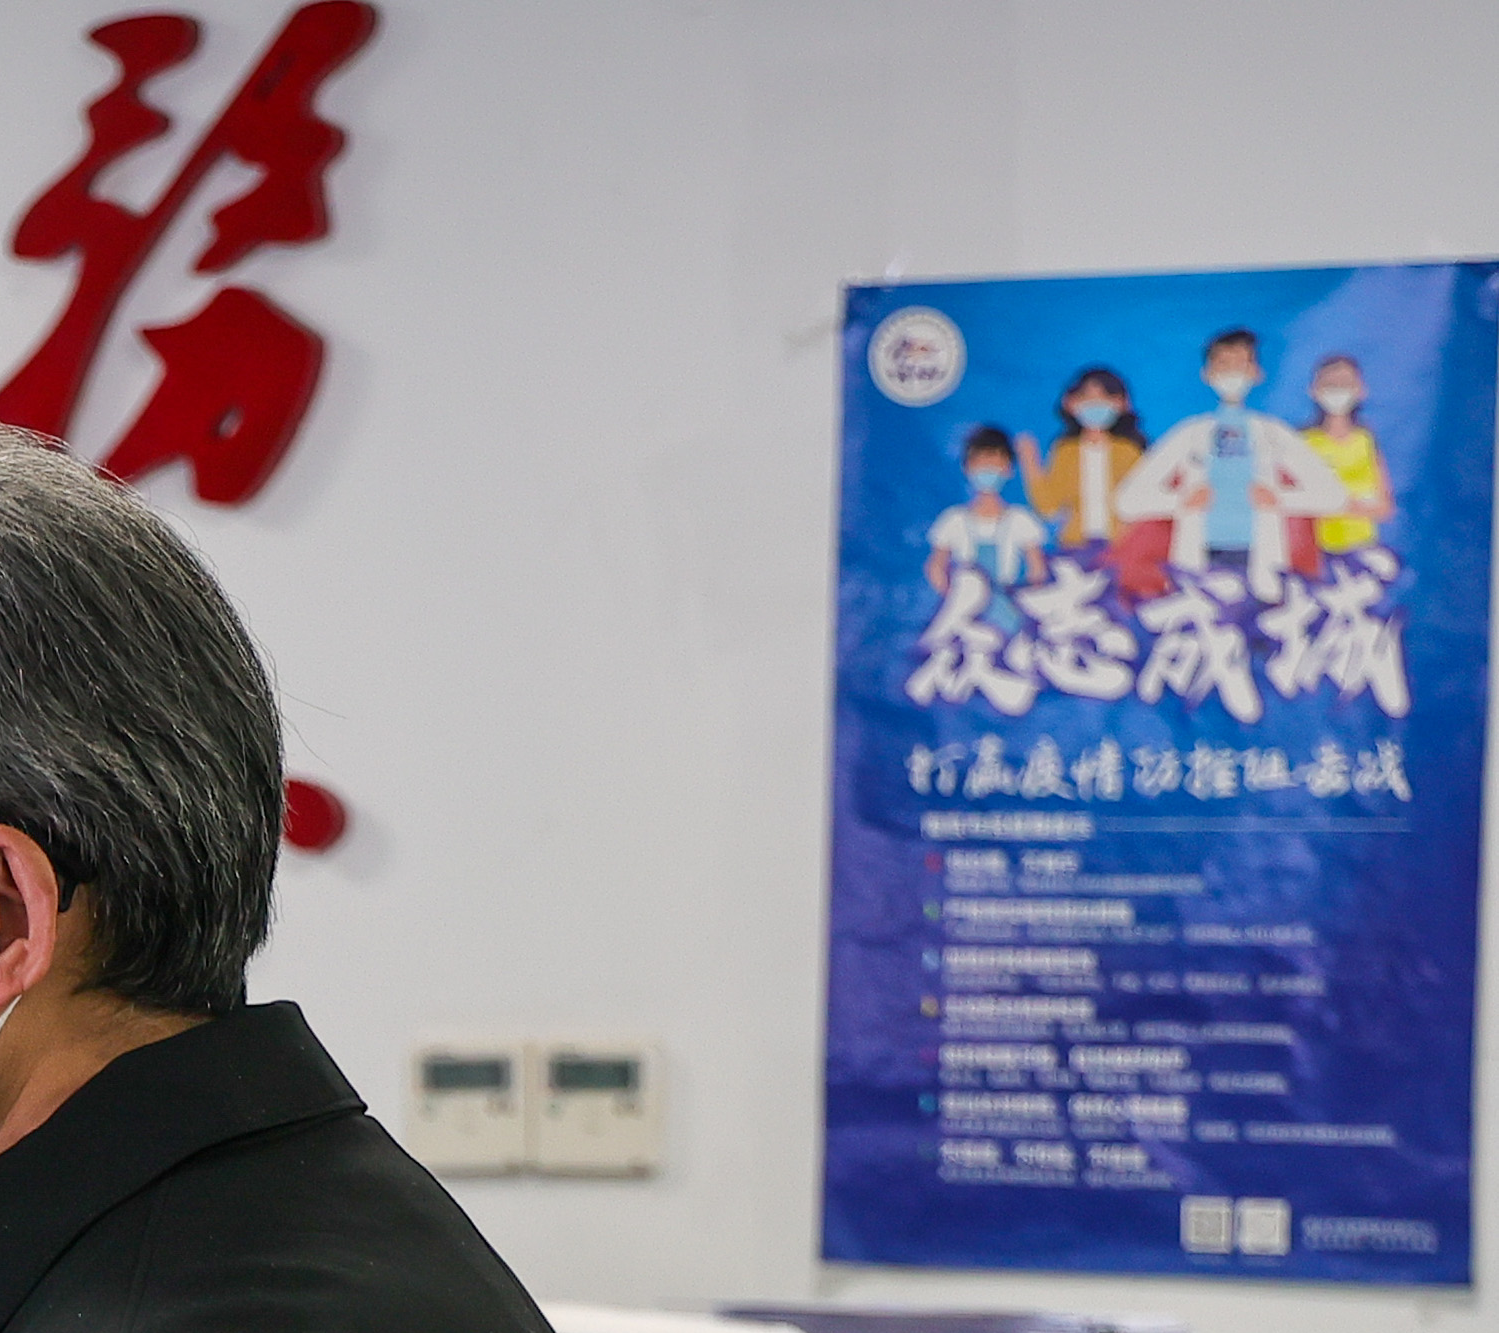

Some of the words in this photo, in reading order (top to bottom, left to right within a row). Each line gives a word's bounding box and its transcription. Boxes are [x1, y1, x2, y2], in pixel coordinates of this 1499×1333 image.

[904, 560, 1411, 722] 众志成城
[907, 736, 1411, 800] 打赢疫情防控阻击战
